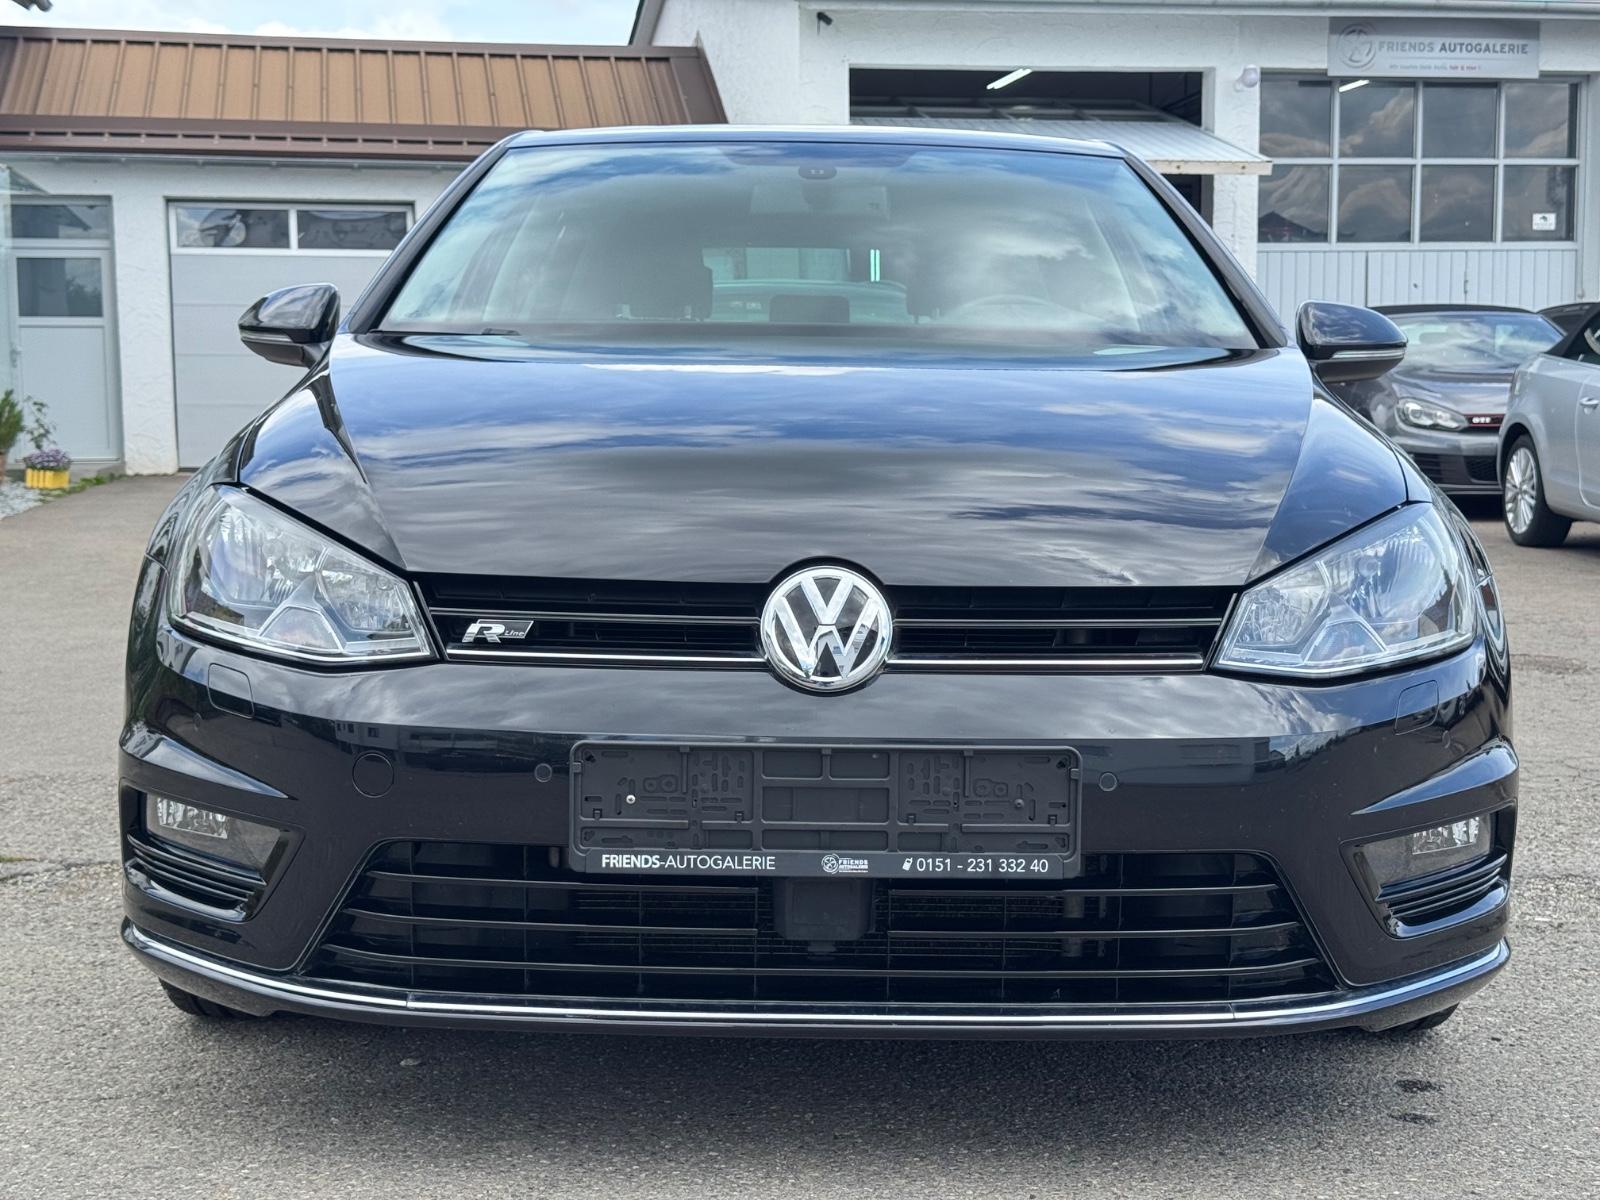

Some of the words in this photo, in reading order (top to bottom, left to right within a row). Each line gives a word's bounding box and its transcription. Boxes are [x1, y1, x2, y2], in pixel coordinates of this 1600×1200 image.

[1378, 41, 1435, 53] FRIENDS
[1438, 42, 1530, 55] AUTOGALERIE
[461, 623, 502, 643] R
[765, 569, 889, 689] VW
[601, 854, 777, 871] FRIENDS-AUTOGALERIE
[916, 857, 951, 872] 0151
[967, 858, 993, 873] 231
[998, 858, 1026, 873] 332
[1030, 858, 1049, 874] 40
